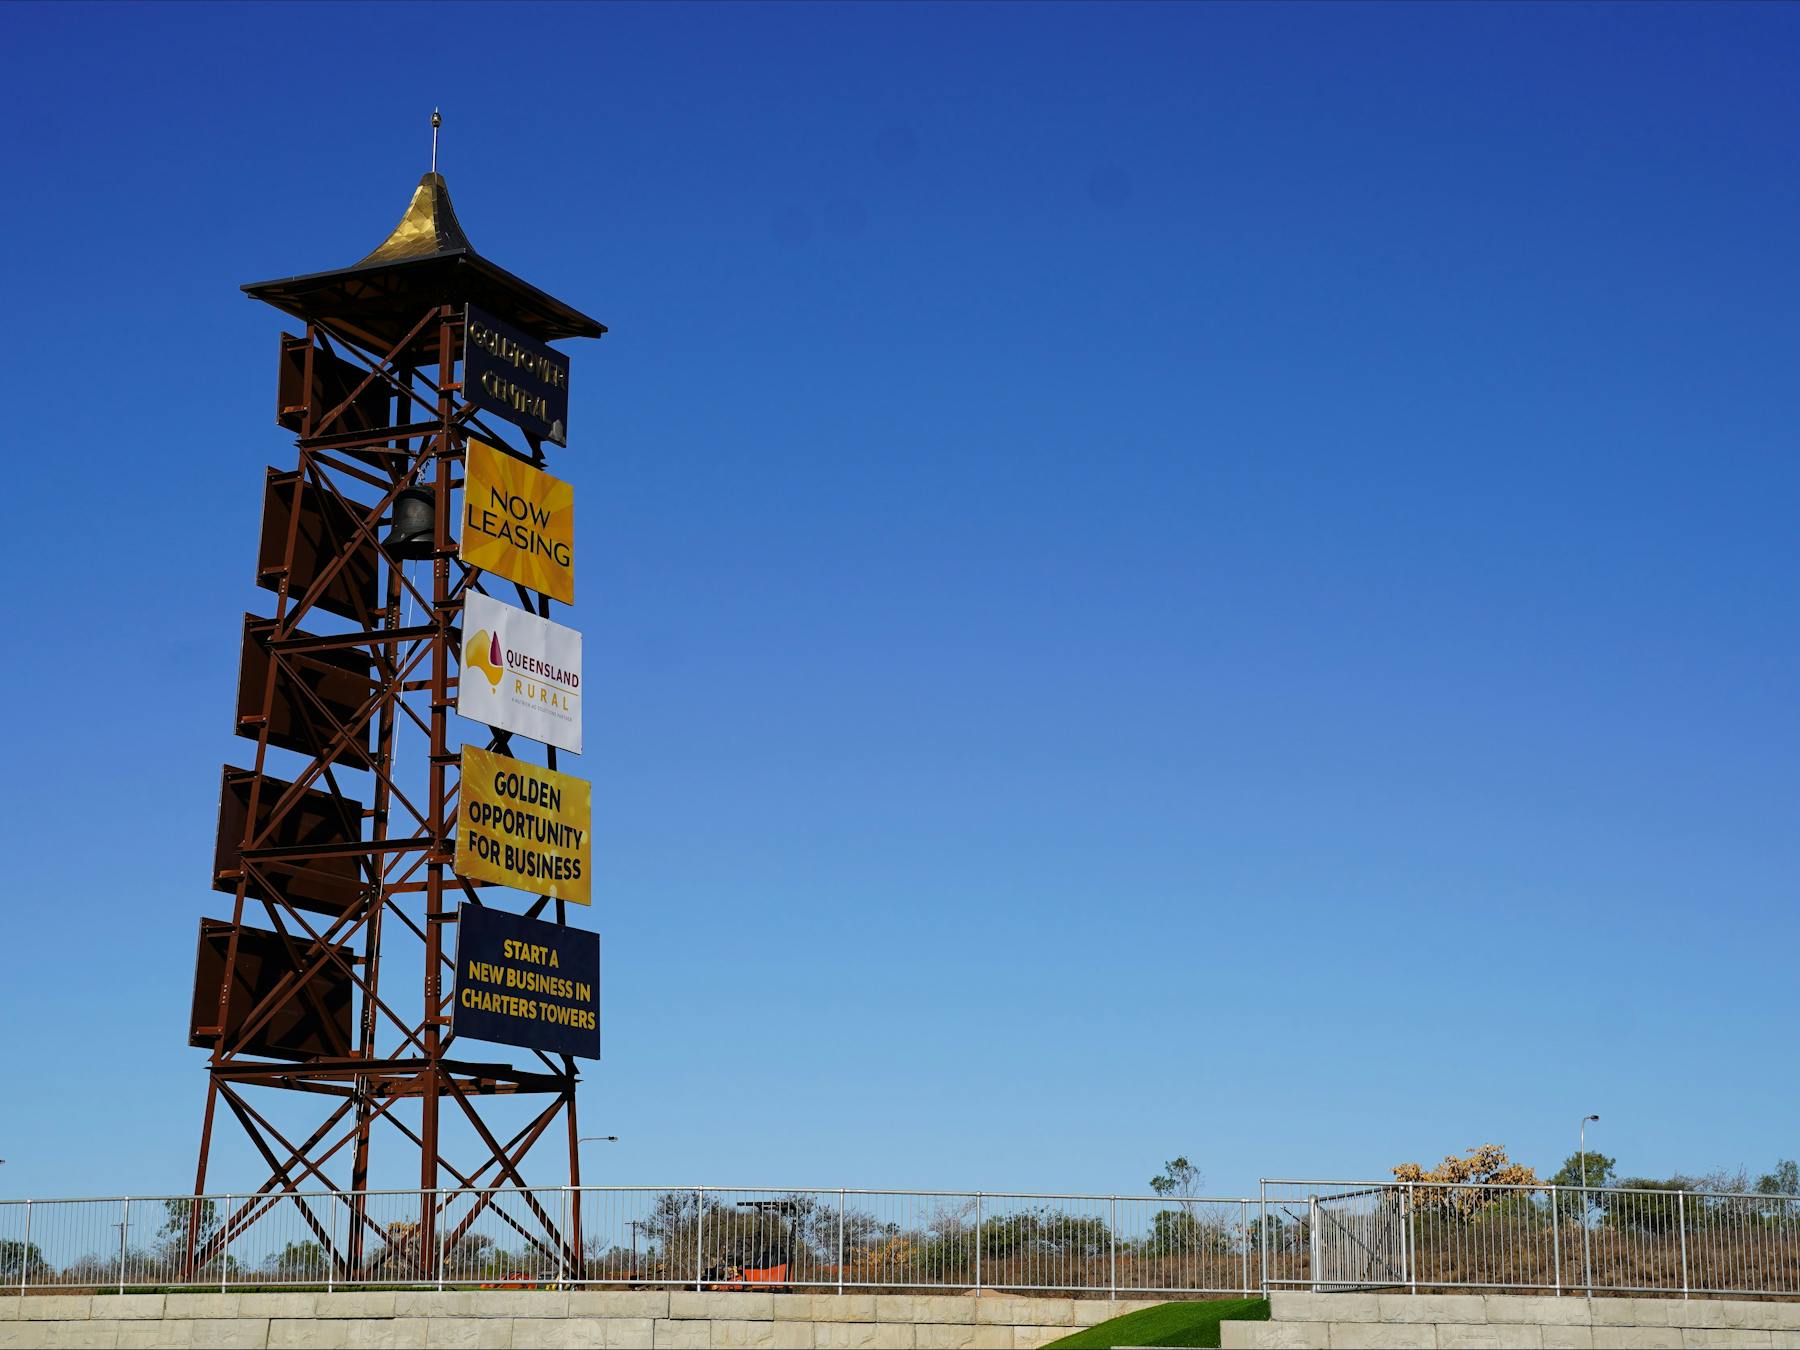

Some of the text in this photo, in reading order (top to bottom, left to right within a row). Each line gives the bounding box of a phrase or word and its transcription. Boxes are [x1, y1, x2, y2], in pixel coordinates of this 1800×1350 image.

[482, 369, 553, 424] CENTRAL
[491, 485, 550, 530] NOW
[468, 503, 570, 567] LEASING
[506, 649, 580, 688] QUEENSLAND
[515, 679, 569, 711] RURAL
[494, 771, 561, 813] GOLDEN
[469, 801, 583, 850] OPPORTUNITY
[469, 830, 581, 880] FOR BUSINESS
[503, 938, 560, 969] START A
[468, 960, 591, 1002] NEW BUSINESS IN
[461, 988, 596, 1030] CHARTERS TOWERS
